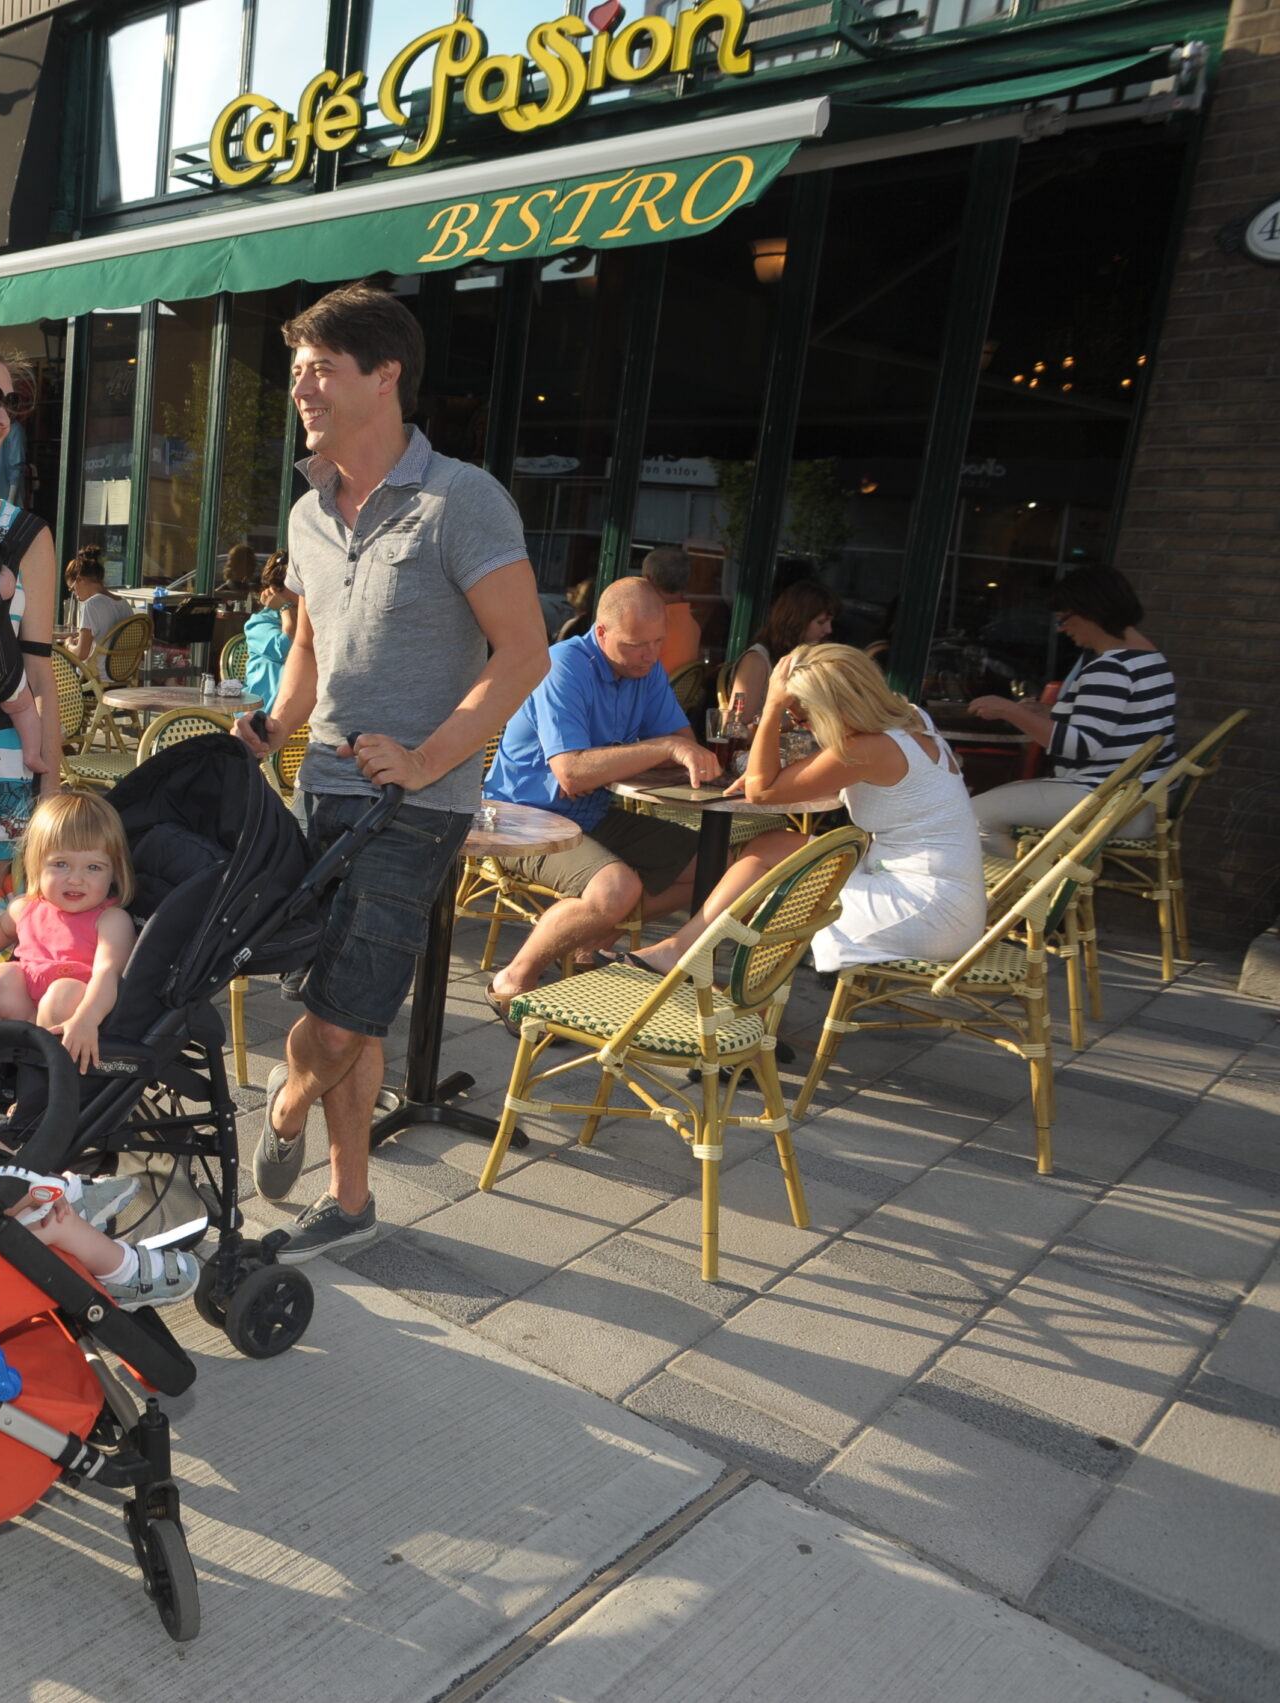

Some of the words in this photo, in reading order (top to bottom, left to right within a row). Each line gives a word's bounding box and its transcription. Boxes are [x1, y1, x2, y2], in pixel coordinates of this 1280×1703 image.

[209, 69, 365, 186] Café
[377, 0, 753, 168] Passion
[417, 154, 754, 264] BISTRO
